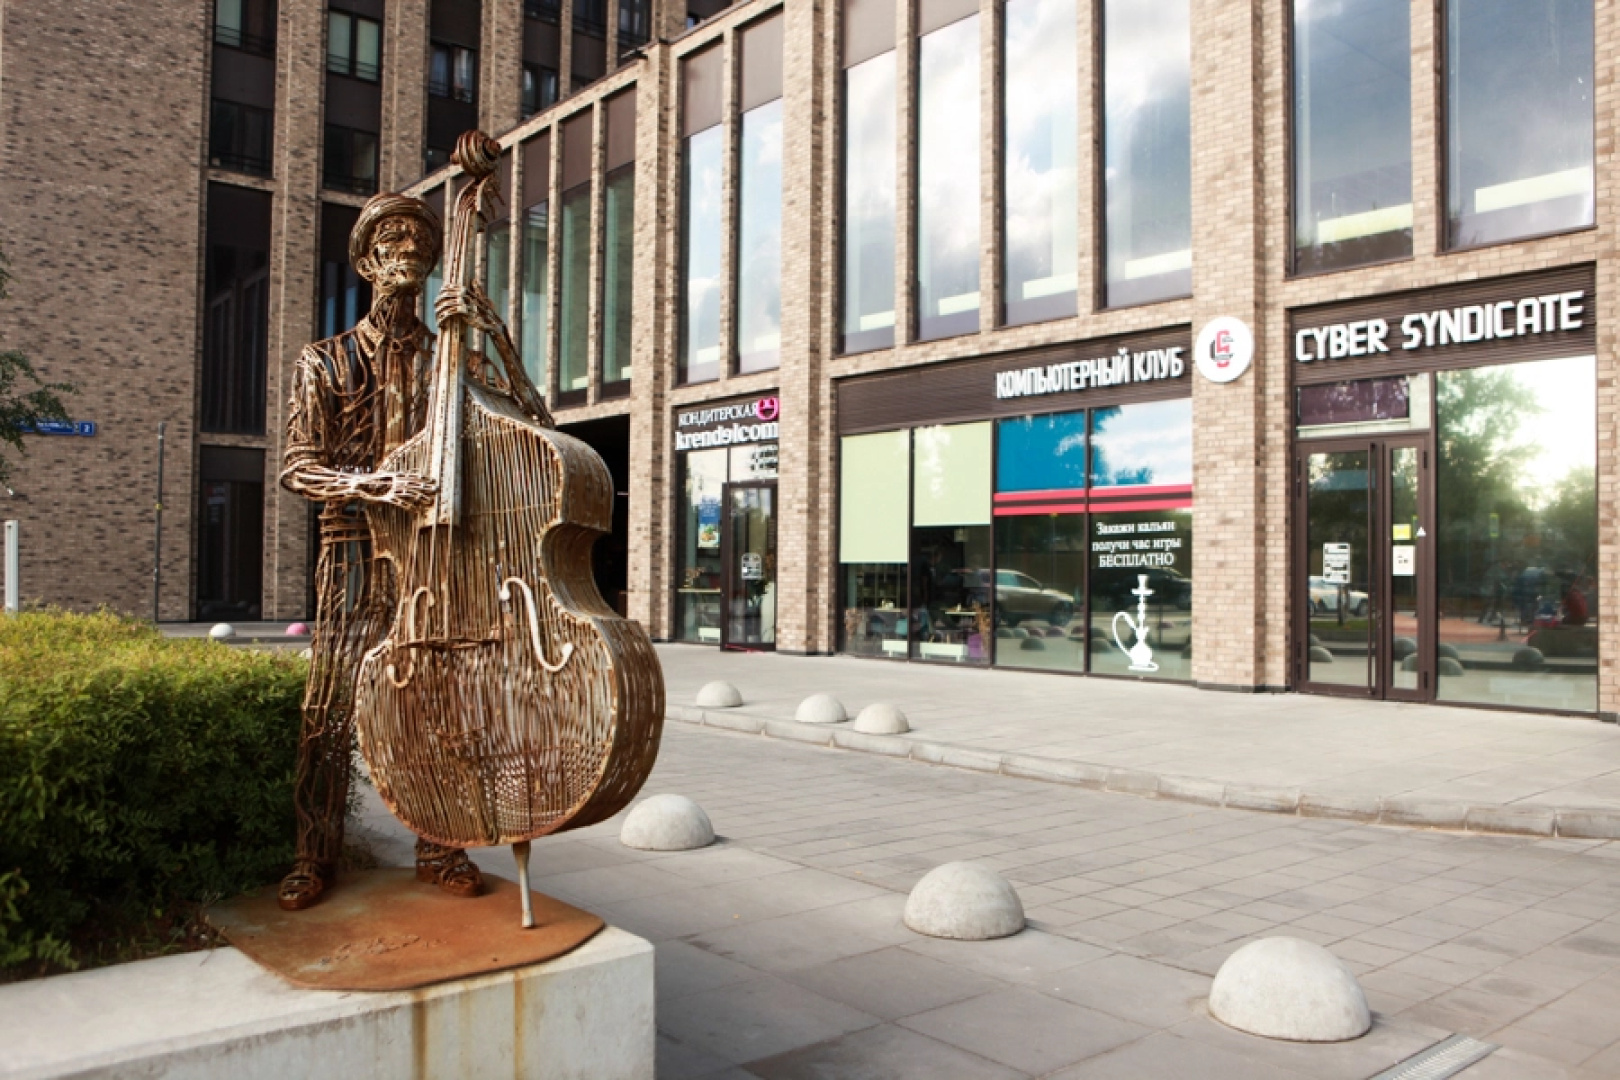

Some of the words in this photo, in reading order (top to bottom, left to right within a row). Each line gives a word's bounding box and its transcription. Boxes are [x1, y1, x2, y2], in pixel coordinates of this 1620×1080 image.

[1295, 318, 1390, 362] CYBER
[1401, 290, 1584, 350] SYNDICATE
[996, 347, 1130, 399] КОМПЬЮТЕРНЫЙ
[1133, 347, 1184, 382] КЛУБ
[678, 403, 758, 427] КОНДИТЕРСКАЯ
[1092, 541, 1130, 553] получи
[1132, 540, 1151, 549] час
[1153, 538, 1182, 551] игры
[1099, 552, 1175, 567] БЕСПЛАТНО
